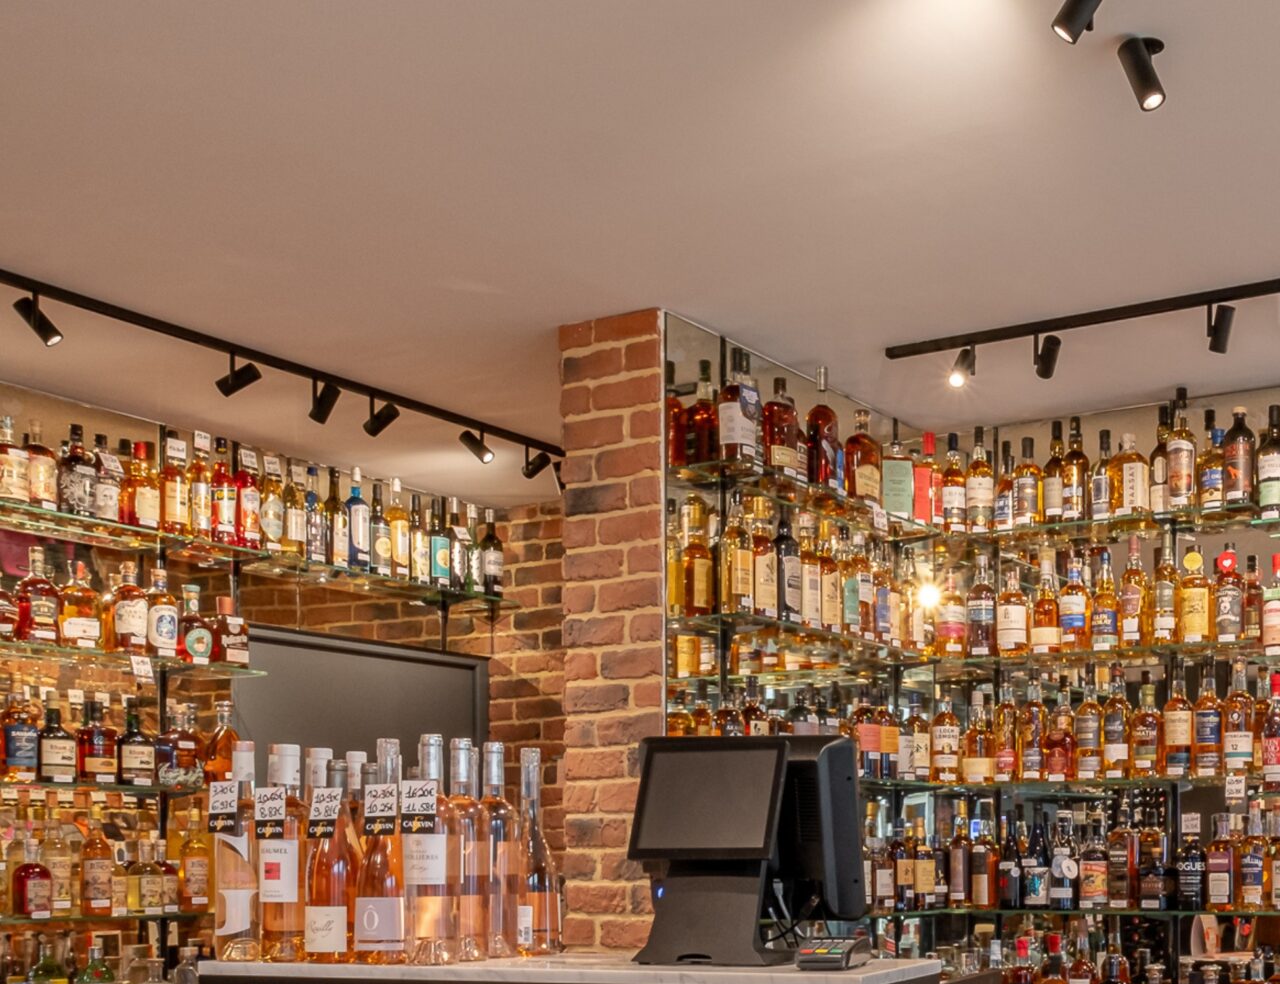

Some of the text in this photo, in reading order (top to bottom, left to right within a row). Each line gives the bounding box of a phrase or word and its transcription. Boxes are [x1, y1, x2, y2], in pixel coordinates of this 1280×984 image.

[209, 820, 235, 828] CAVIN
[365, 822, 394, 831] CAVIN
[402, 819, 434, 829] CAVIN
[256, 825, 283, 834] CAVIN
[309, 825, 334, 834] CAVIN
[1176, 861, 1206, 871] OGUES
